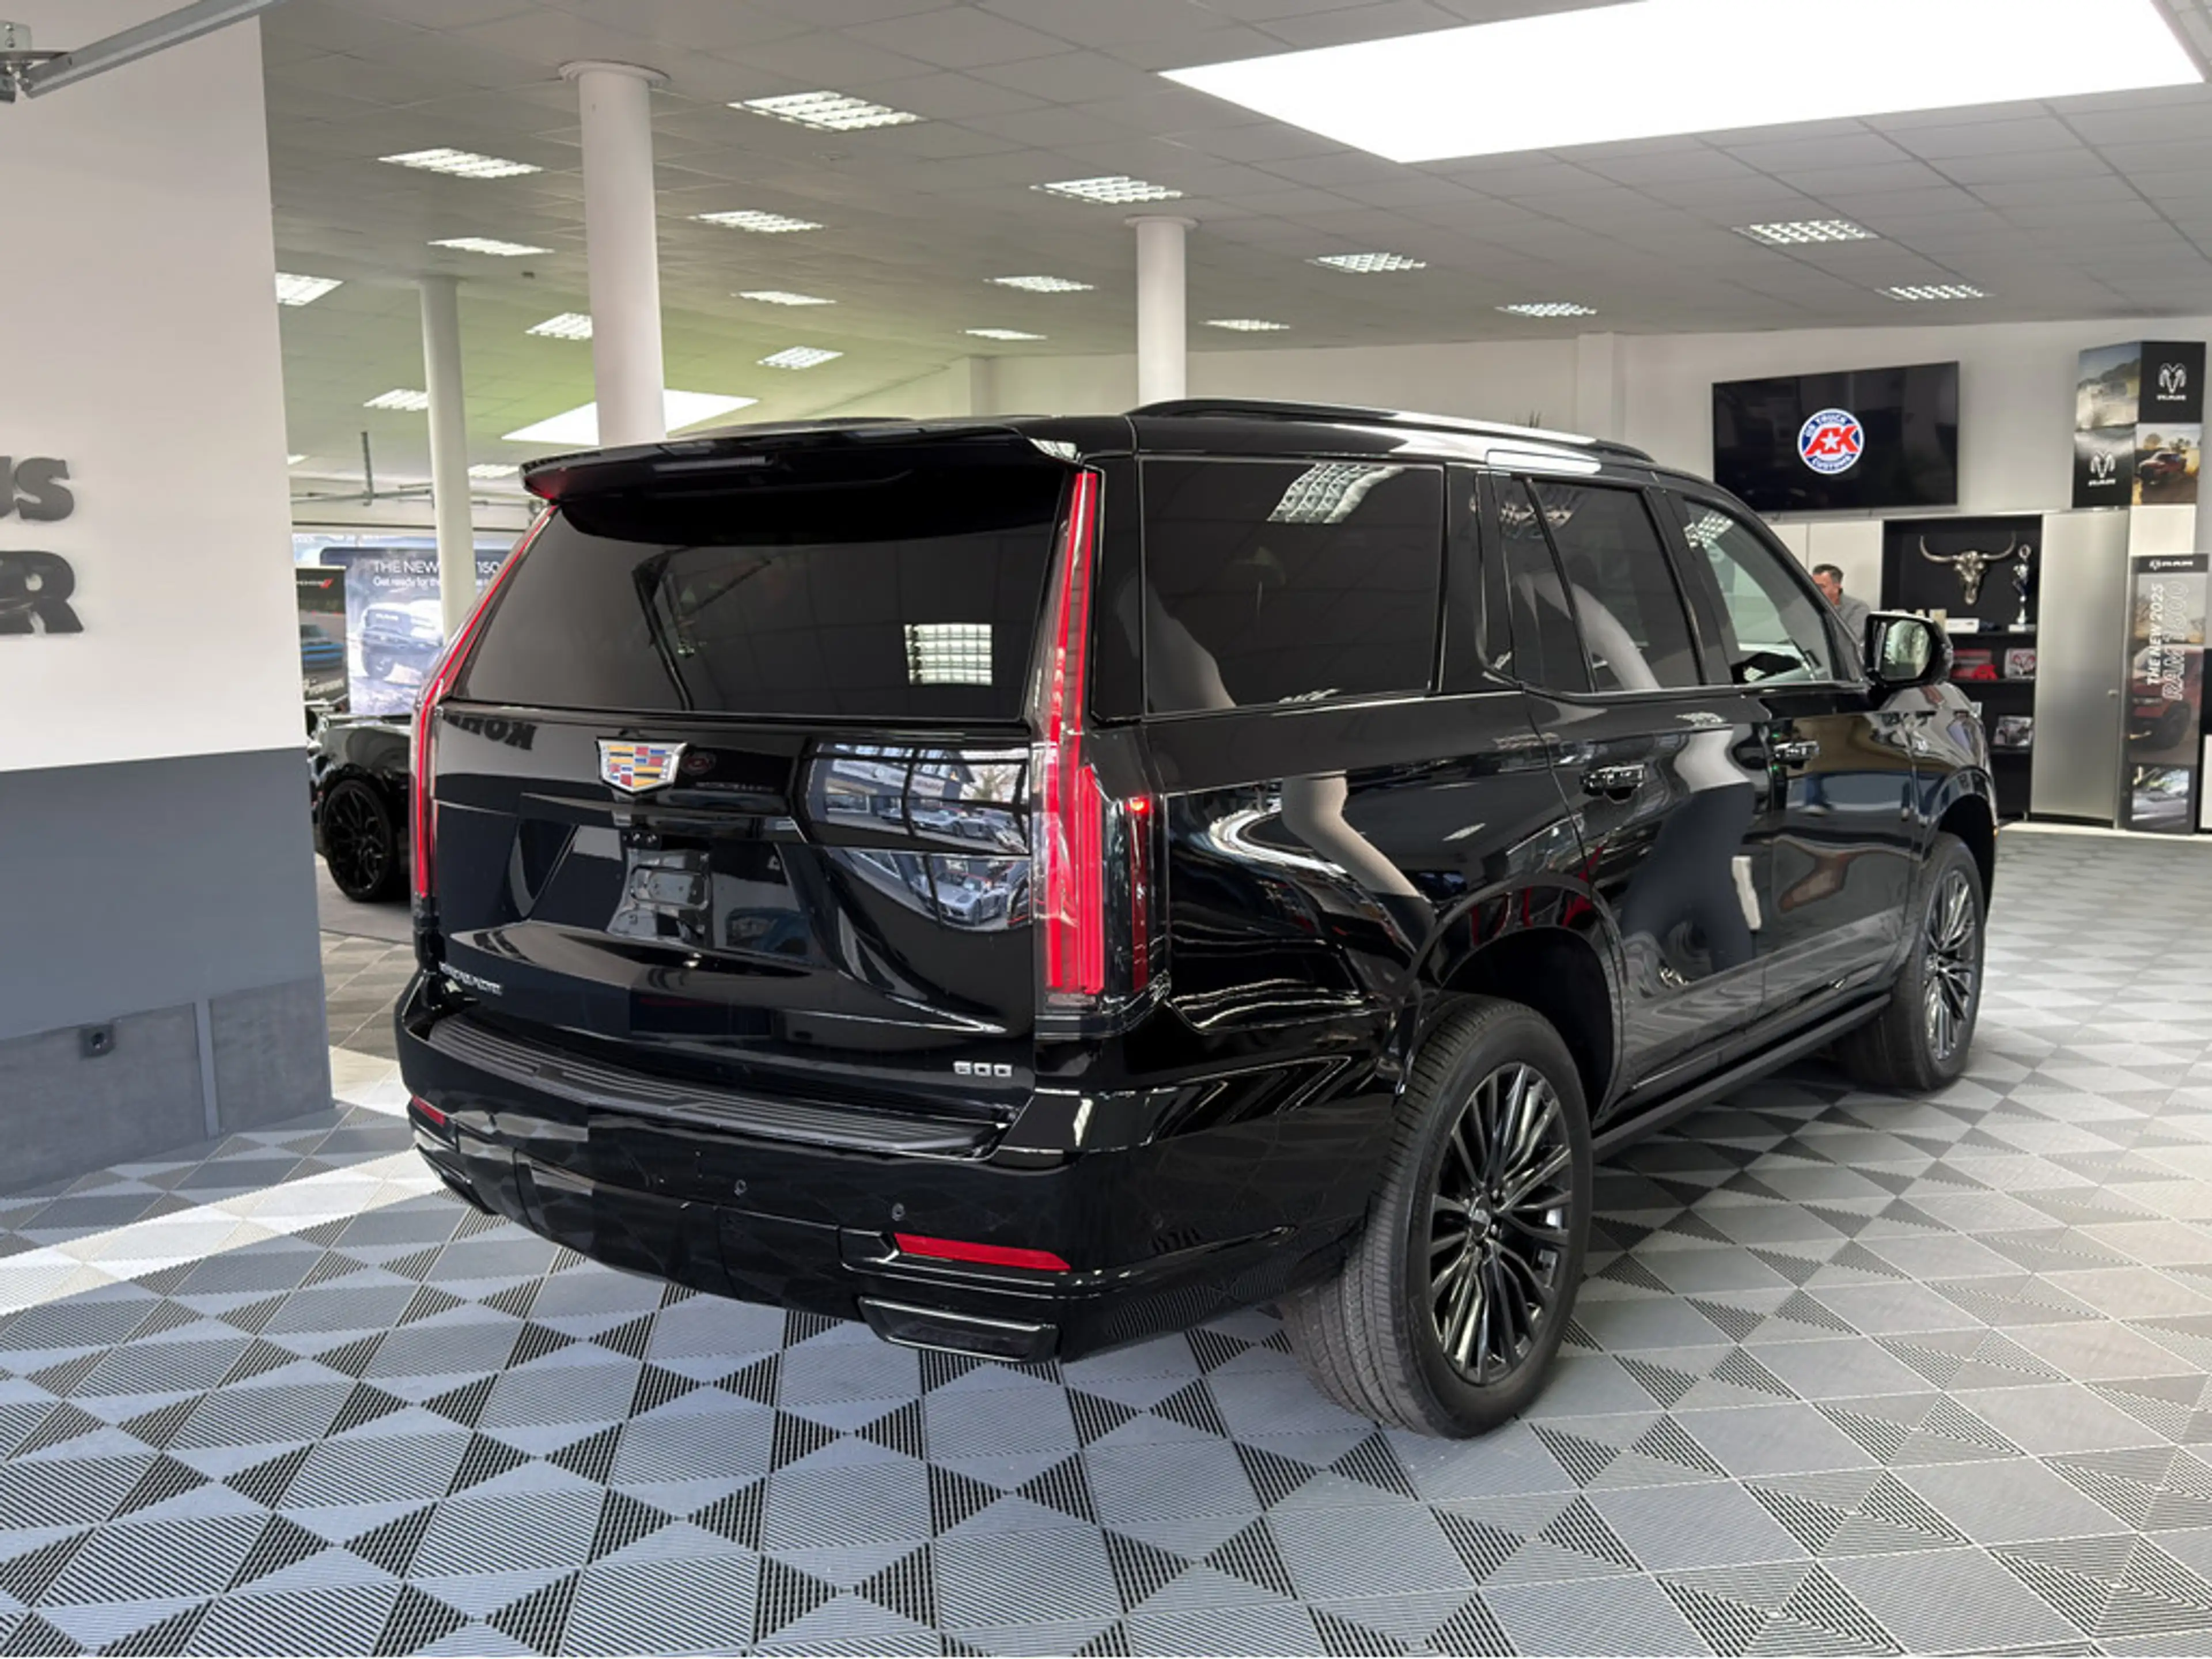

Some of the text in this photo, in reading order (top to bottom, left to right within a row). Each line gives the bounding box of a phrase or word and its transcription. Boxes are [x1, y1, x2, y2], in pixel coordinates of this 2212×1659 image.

[0, 456, 74, 522] S
[374, 560, 501, 574] THE NEW 150
[0, 550, 84, 634] R
[2150, 582, 2164, 621] 2025
[2149, 625, 2162, 657] NEW
[2147, 659, 2162, 685] THE
[953, 1060, 1012, 1078] 600
